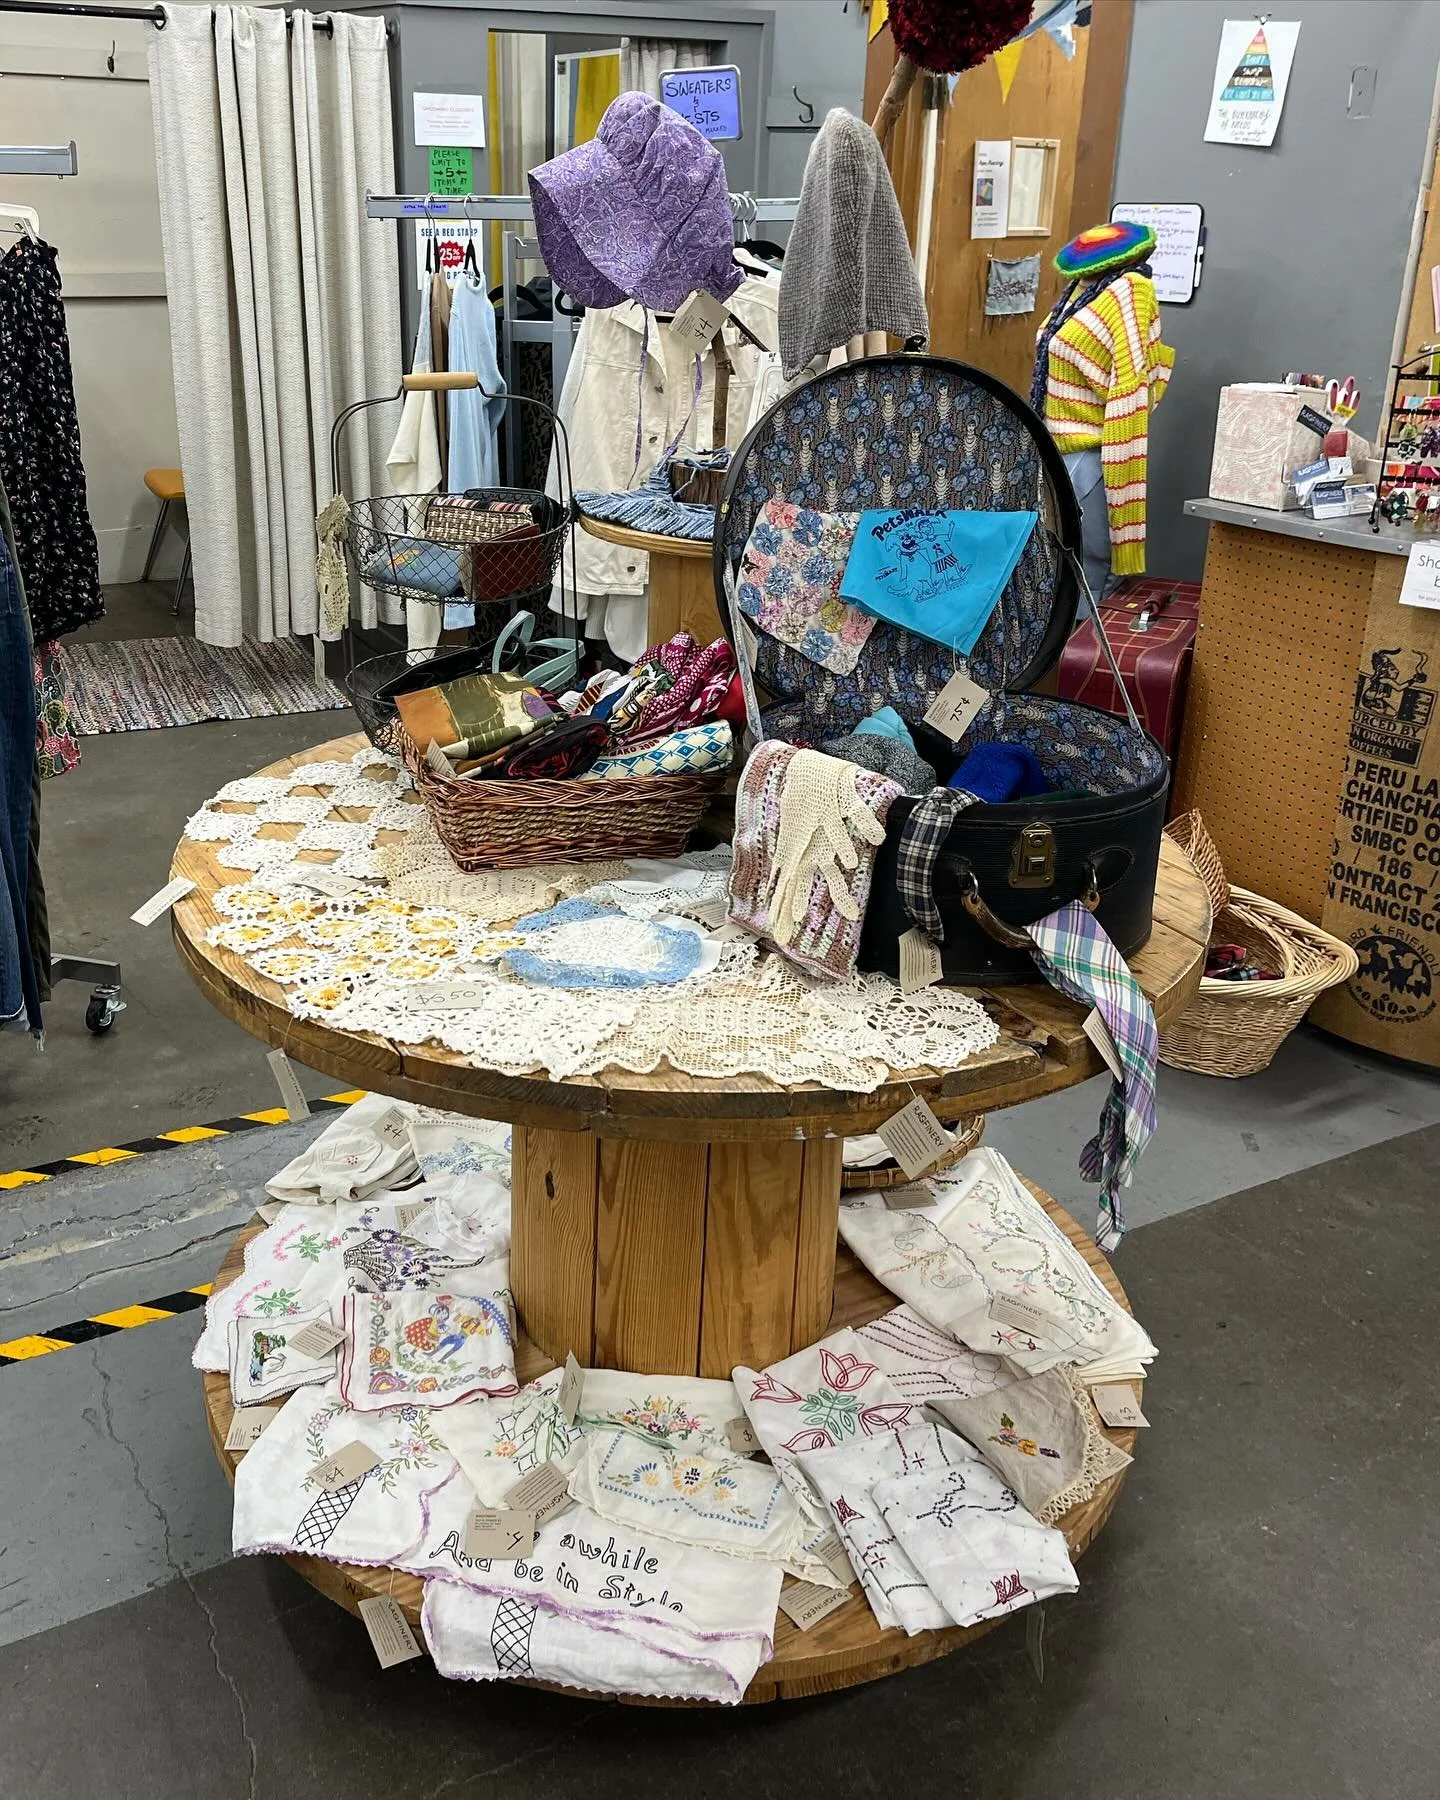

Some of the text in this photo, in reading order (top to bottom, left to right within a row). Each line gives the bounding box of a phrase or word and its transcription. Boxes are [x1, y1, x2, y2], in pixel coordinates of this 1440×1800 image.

[664, 78, 731, 97] SWEATERS
[681, 110, 720, 125] ESTS
[433, 149, 460, 158] PLEASE
[456, 158, 466, 166] TO
[445, 167, 454, 178] 5
[421, 228, 433, 237] SEE
[442, 228, 455, 237] RED
[457, 228, 478, 237] STAR?
[1362, 730, 1414, 751] ORGANIC
[1400, 725, 1421, 738] BY
[1354, 759, 1408, 789] PERU
[1338, 797, 1418, 837] RTIFIED
[1351, 824, 1408, 857] SMBC
[1377, 854, 1413, 880] 186
[1330, 861, 1428, 906] ONTRACT
[1339, 886, 1440, 935] FRANCISC
[383, 1123, 403, 1139] $4
[914, 1104, 945, 1147] RAGFINERY
[560, 1534, 659, 1575] awhile
[514, 1558, 544, 1583] be
[556, 1561, 579, 1594] in
